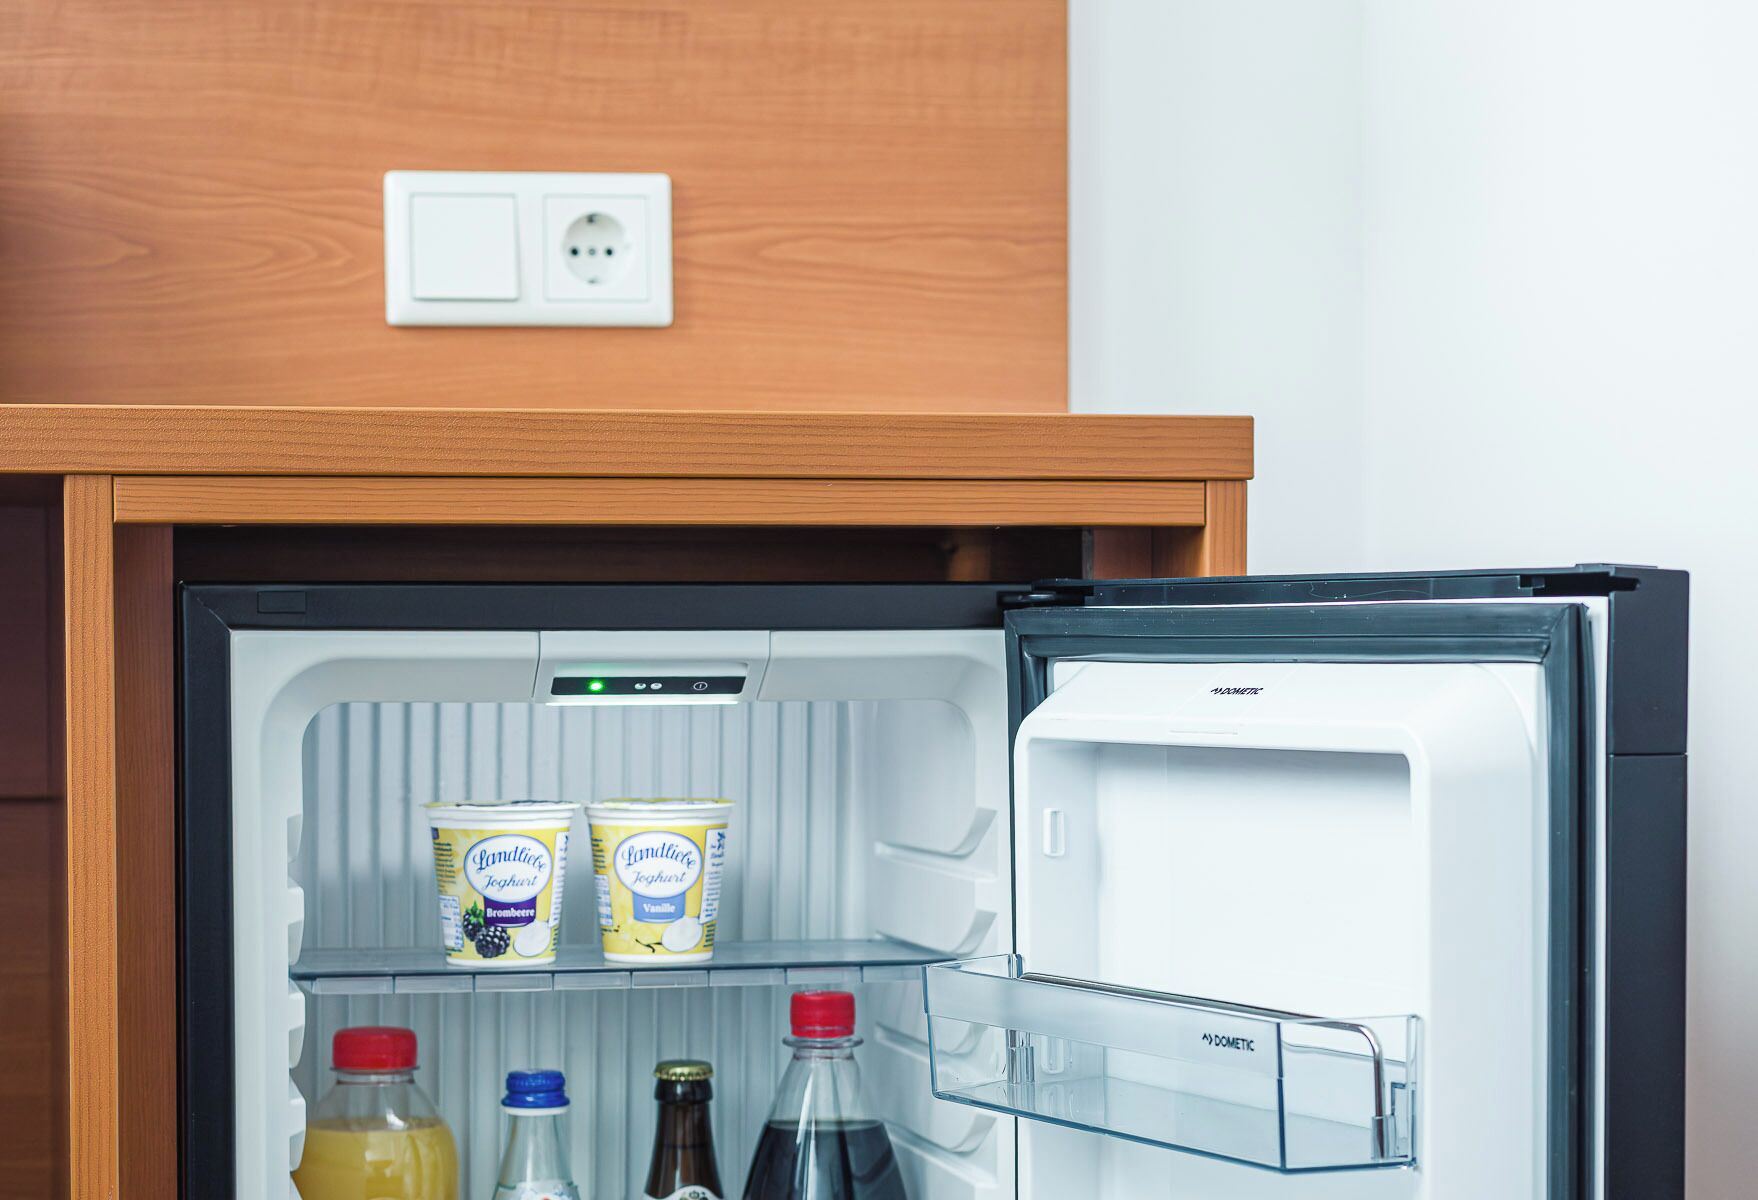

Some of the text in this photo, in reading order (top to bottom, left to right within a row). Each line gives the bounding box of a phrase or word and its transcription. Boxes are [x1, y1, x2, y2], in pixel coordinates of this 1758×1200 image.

[472, 845, 547, 873] Landliebe
[621, 842, 697, 870] Landliebe
[483, 873, 538, 892] Joghurt
[631, 871, 687, 889] Joghurt
[486, 906, 535, 918] Brombeere
[643, 902, 676, 914] Vanille
[1214, 1034, 1255, 1052] DOMETIC
